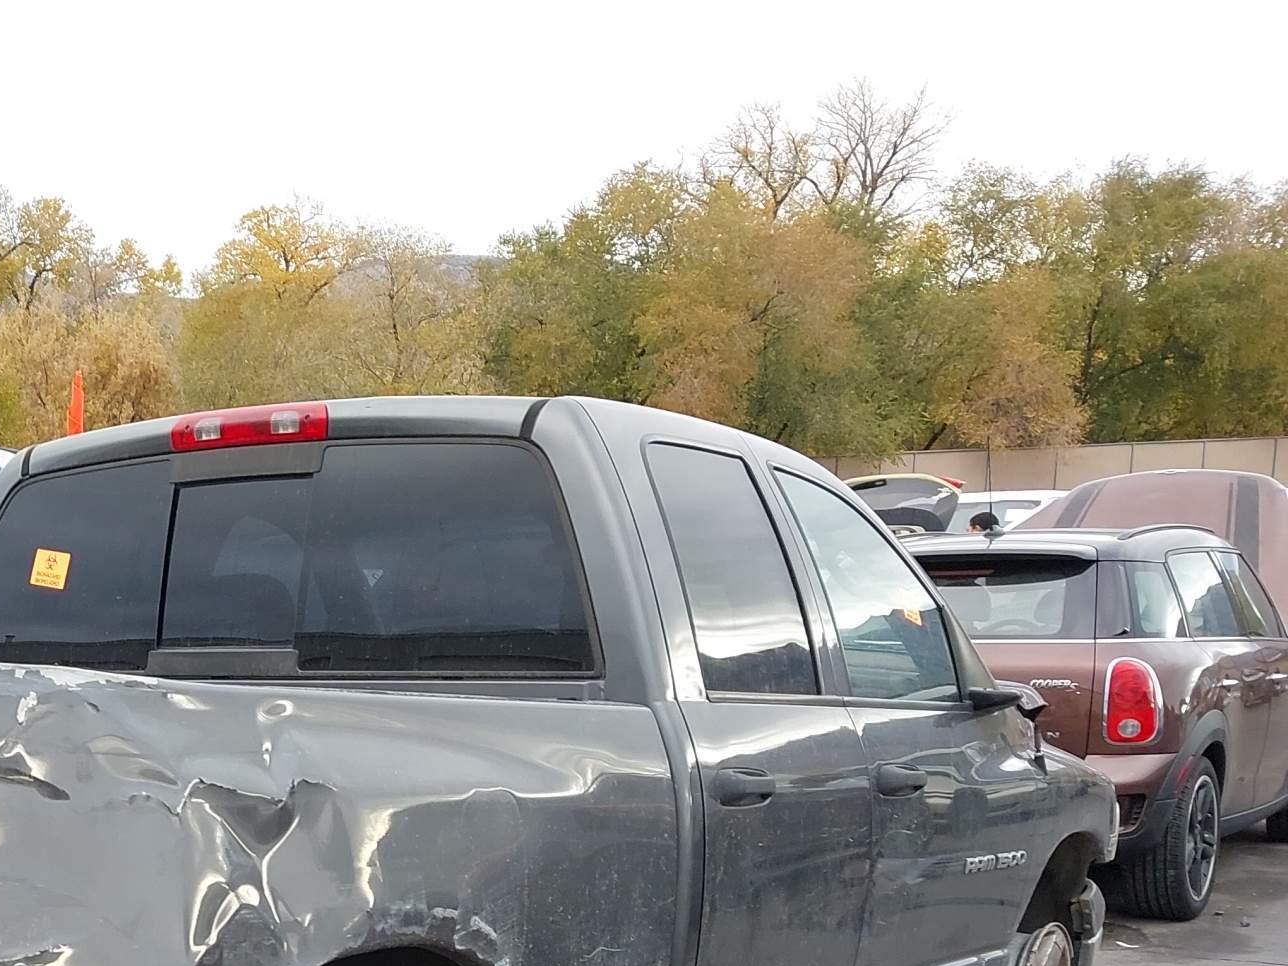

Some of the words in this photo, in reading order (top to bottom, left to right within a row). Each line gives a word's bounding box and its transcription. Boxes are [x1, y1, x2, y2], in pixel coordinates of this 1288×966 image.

[1030, 679, 1072, 688] COOPER
[964, 854, 996, 875] RAM
[996, 850, 1028, 870] 1500
